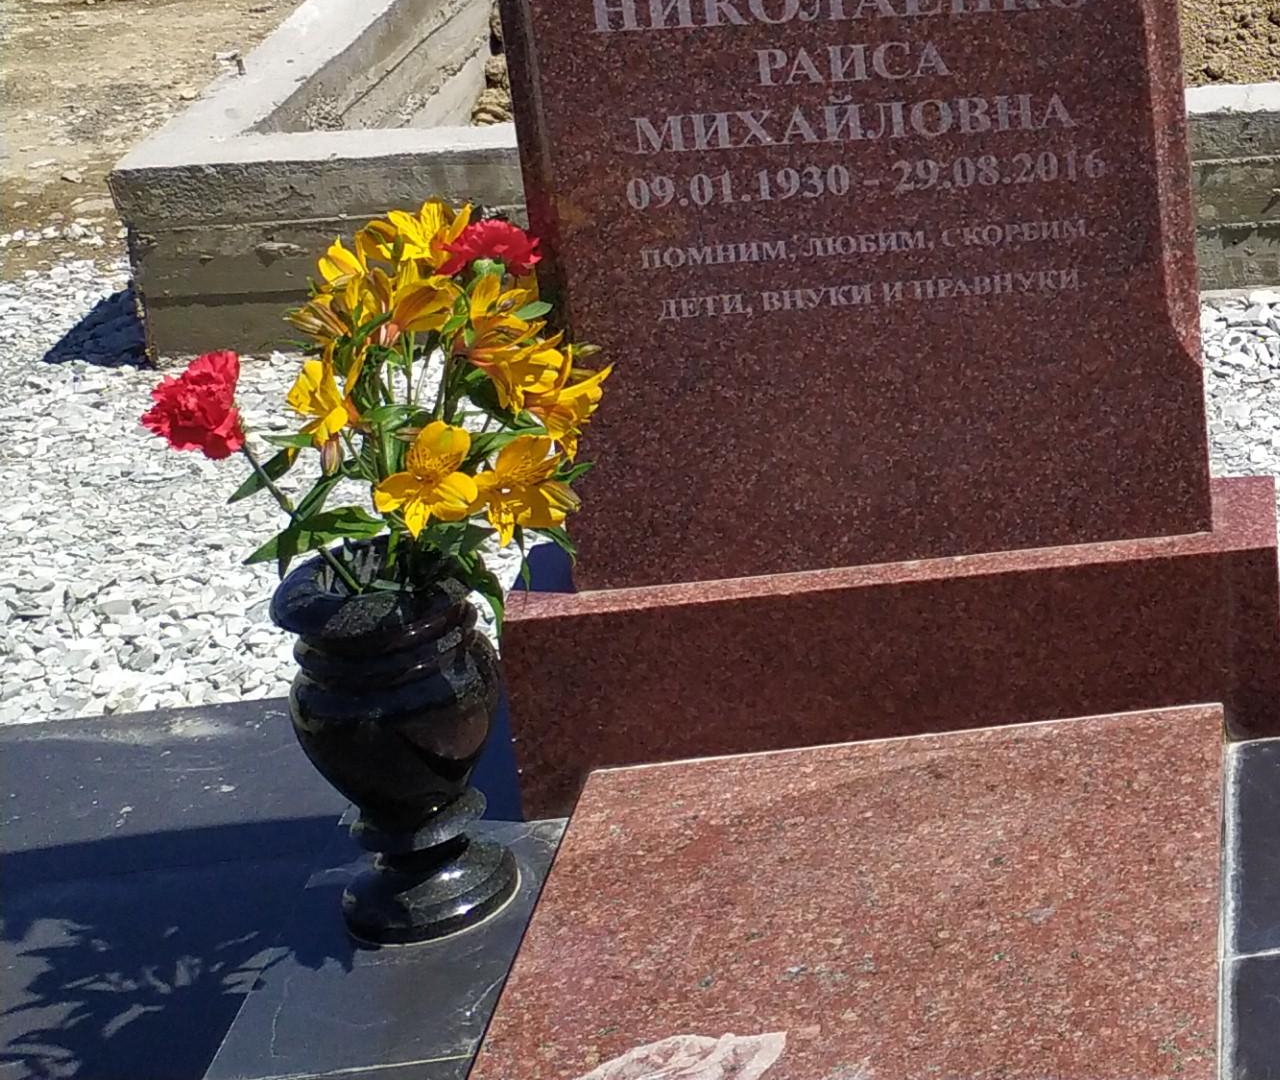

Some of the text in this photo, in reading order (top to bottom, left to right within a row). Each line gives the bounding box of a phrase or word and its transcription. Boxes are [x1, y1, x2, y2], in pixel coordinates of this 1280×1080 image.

[754, 41, 953, 86] РАИСА
[629, 93, 1078, 155] МИХАЙЛОВНА
[626, 164, 850, 210] 09.01.1930
[895, 150, 1107, 192] 29.08.2016
[640, 239, 797, 270] ПОМНИМ,
[802, 230, 934, 258] ЛЮБИМ,
[658, 294, 753, 322] ДЕТИ,
[762, 284, 872, 312] ВНУКИ
[882, 281, 901, 301] И
